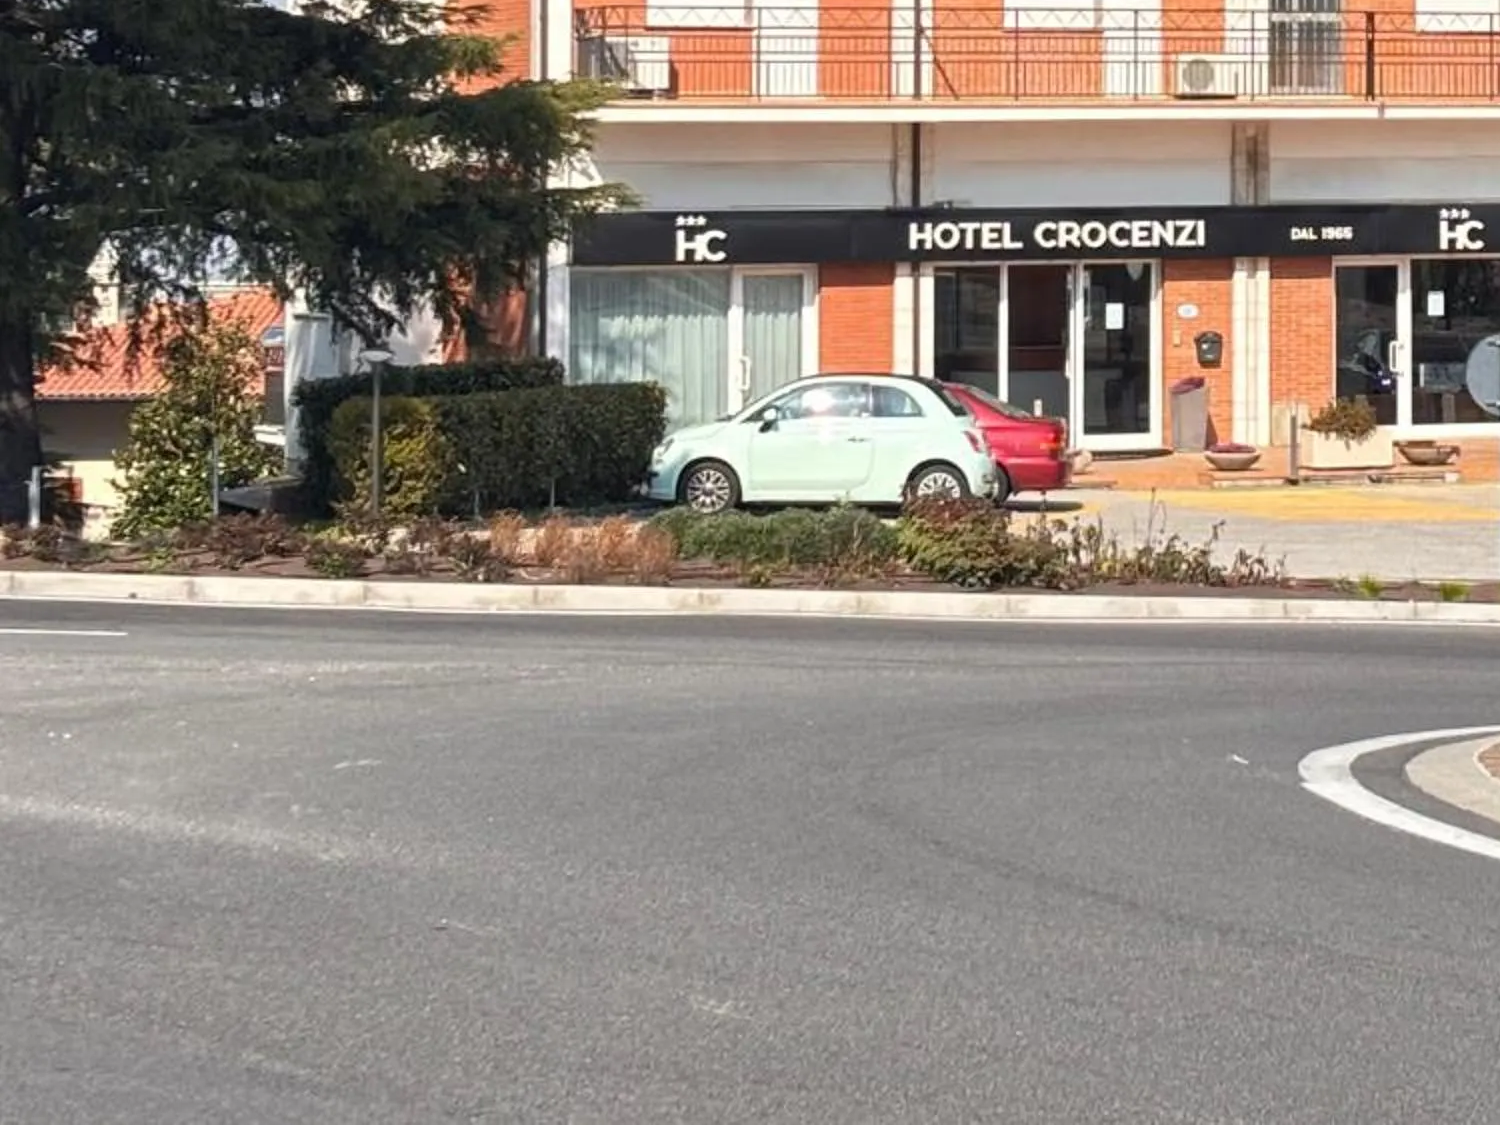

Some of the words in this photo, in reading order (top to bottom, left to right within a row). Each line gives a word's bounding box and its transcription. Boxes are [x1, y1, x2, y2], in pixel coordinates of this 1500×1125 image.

[675, 229, 727, 262] HC
[908, 222, 1024, 250] HOTEL
[1033, 220, 1206, 248] CROCENZI
[1290, 226, 1318, 241] DAL
[1321, 226, 1354, 240] 1965
[1439, 219, 1485, 250] HC
